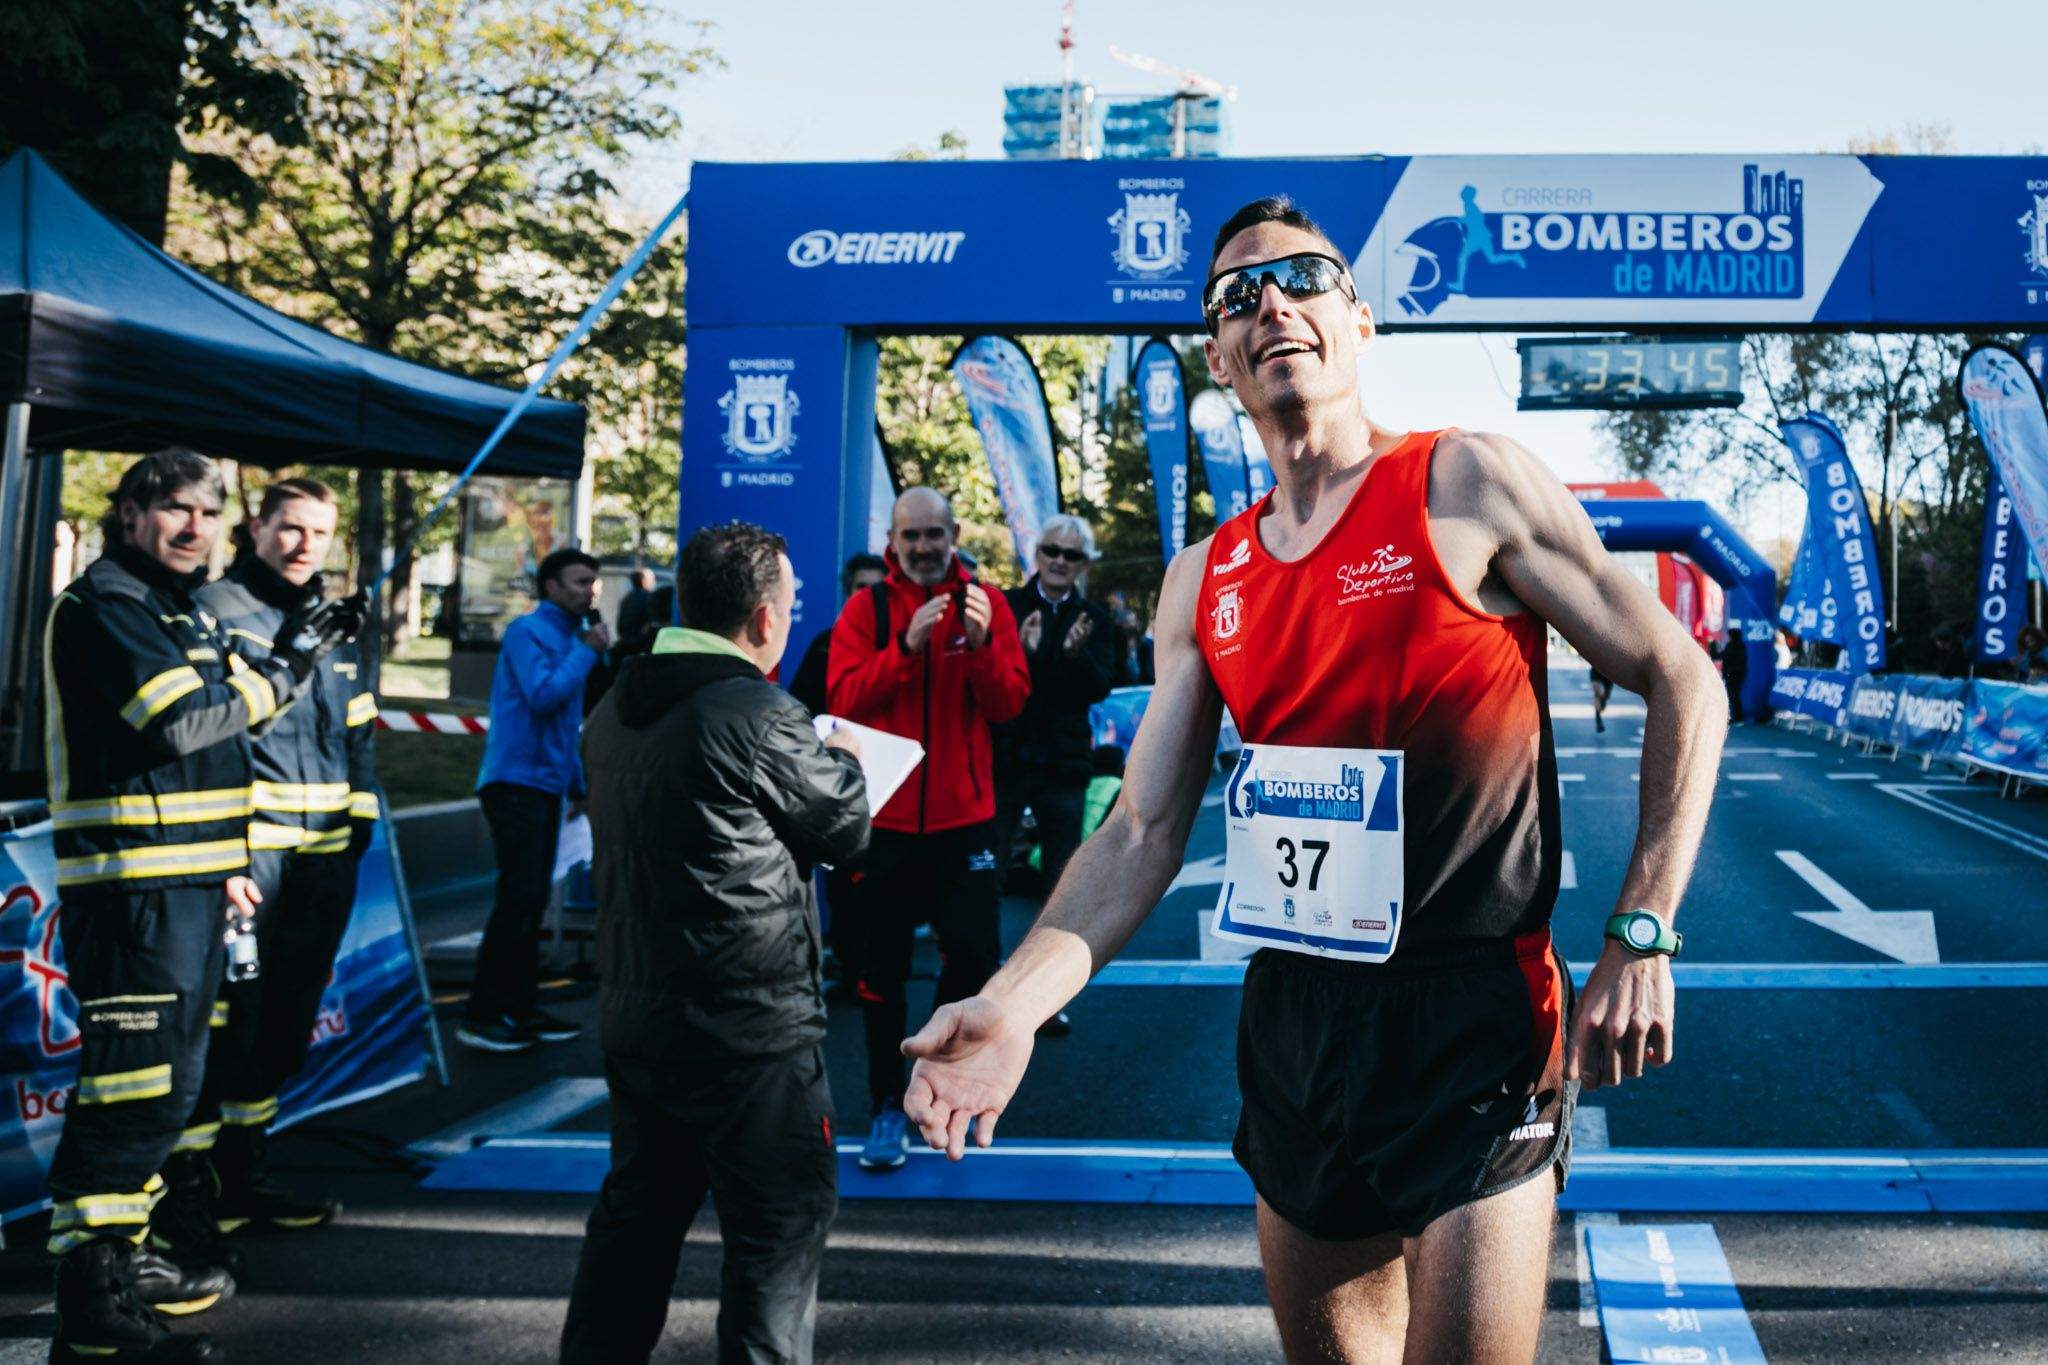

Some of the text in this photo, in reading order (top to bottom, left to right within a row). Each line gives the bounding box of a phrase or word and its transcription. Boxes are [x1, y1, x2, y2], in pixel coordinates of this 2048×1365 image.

[1118, 178, 1185, 190] BOMBEROS
[1502, 187, 1592, 207] CARRERA
[1501, 214, 1794, 251] BOMBEROS
[834, 231, 966, 264] ENERVIT
[1614, 253, 1795, 293] de MADRID
[1130, 288, 1187, 302] MADRID
[728, 358, 795, 371] BOMBEROS
[738, 472, 795, 486] MADRID
[1342, 572, 1414, 594] Deportivo
[1337, 583, 1415, 606] bomberos de madrid
[1264, 781, 1360, 802] BOMBEROS
[1299, 801, 1361, 819] de MADRID
[1276, 837, 1330, 891] 37
